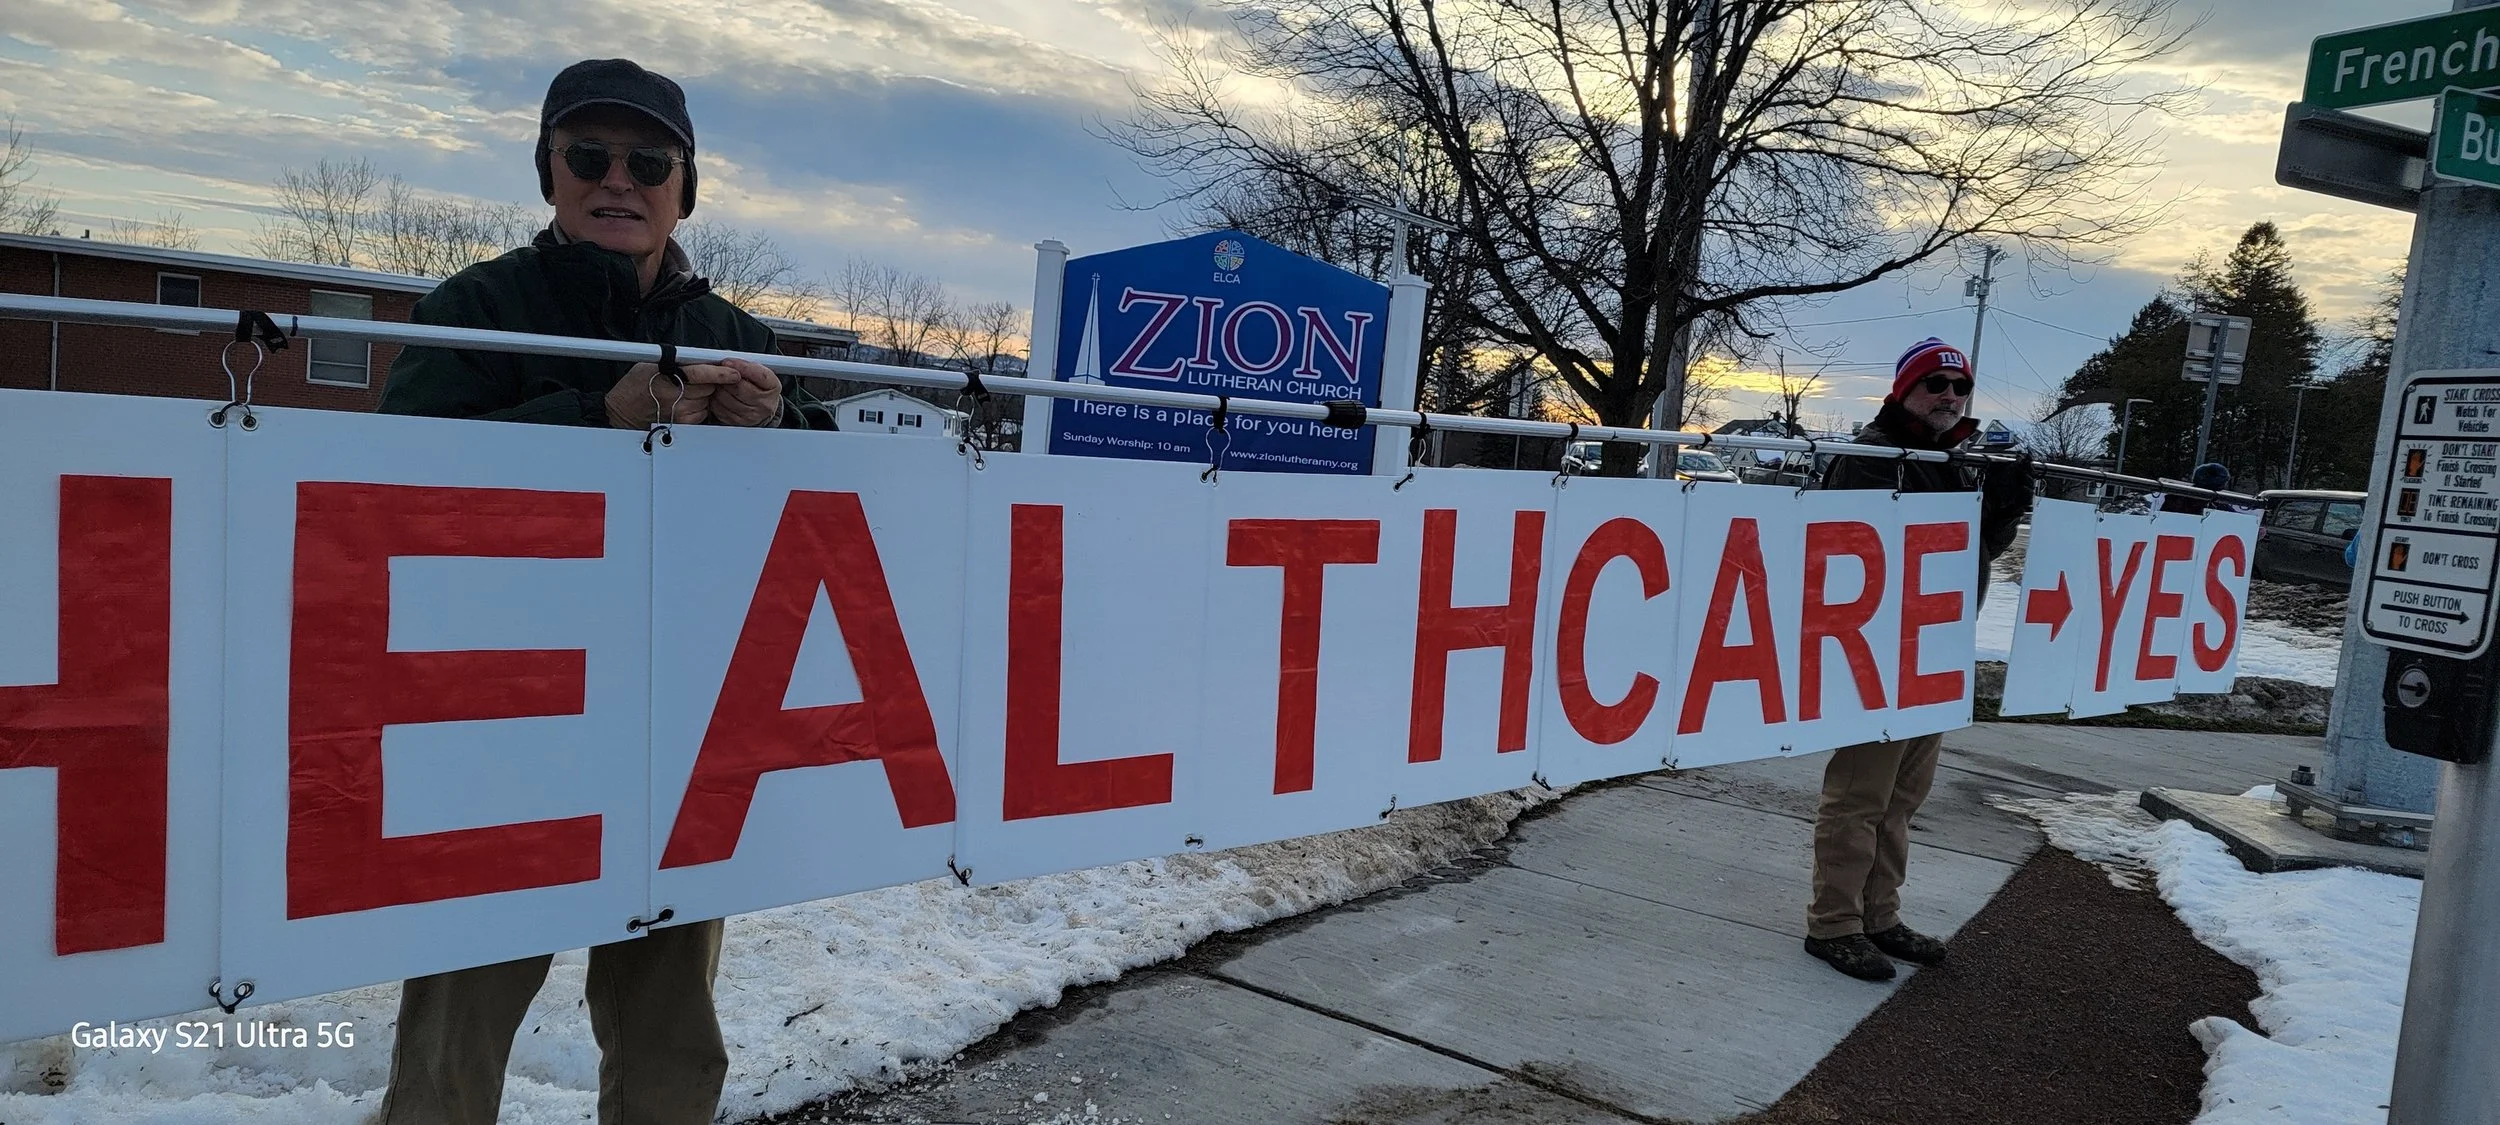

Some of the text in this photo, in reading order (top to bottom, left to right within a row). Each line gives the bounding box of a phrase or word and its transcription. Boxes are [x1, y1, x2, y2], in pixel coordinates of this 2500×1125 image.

[2333, 26, 2500, 93] French
[1213, 272, 1240, 284] ELCA
[1109, 286, 1373, 384] ZION
[1187, 371, 1362, 400] LUTHERAN CHURCH
[2444, 388, 2470, 401] START
[2456, 405, 2497, 418] Watch For
[1133, 404, 1150, 420] is
[1156, 410, 1167, 421] a
[1235, 415, 1262, 430] for
[1265, 420, 1303, 436] you
[1309, 421, 1359, 441] here!
[2458, 419, 2490, 432] Vehicles
[1063, 431, 1191, 453] Sunday Worship: 10 am
[2442, 443, 2498, 457] DON'T START
[1230, 450, 1359, 471] www.zionlutheranny.org
[2437, 459, 2497, 478] Finish Crossing
[2453, 474, 2483, 488] Started
[2428, 494, 2499, 511] TIME REMAINING
[2424, 509, 2433, 521] To
[2437, 510, 2460, 524] Finish
[2463, 512, 2498, 530] Crossing
[2423, 551, 2480, 570] DON'T CROSS
[2393, 590, 2462, 612] PUSH BUTTON
[2095, 534, 2246, 692] YES
[2399, 615, 2448, 635] TO CROSS
[0, 474, 1970, 956] HEALTHCARE
